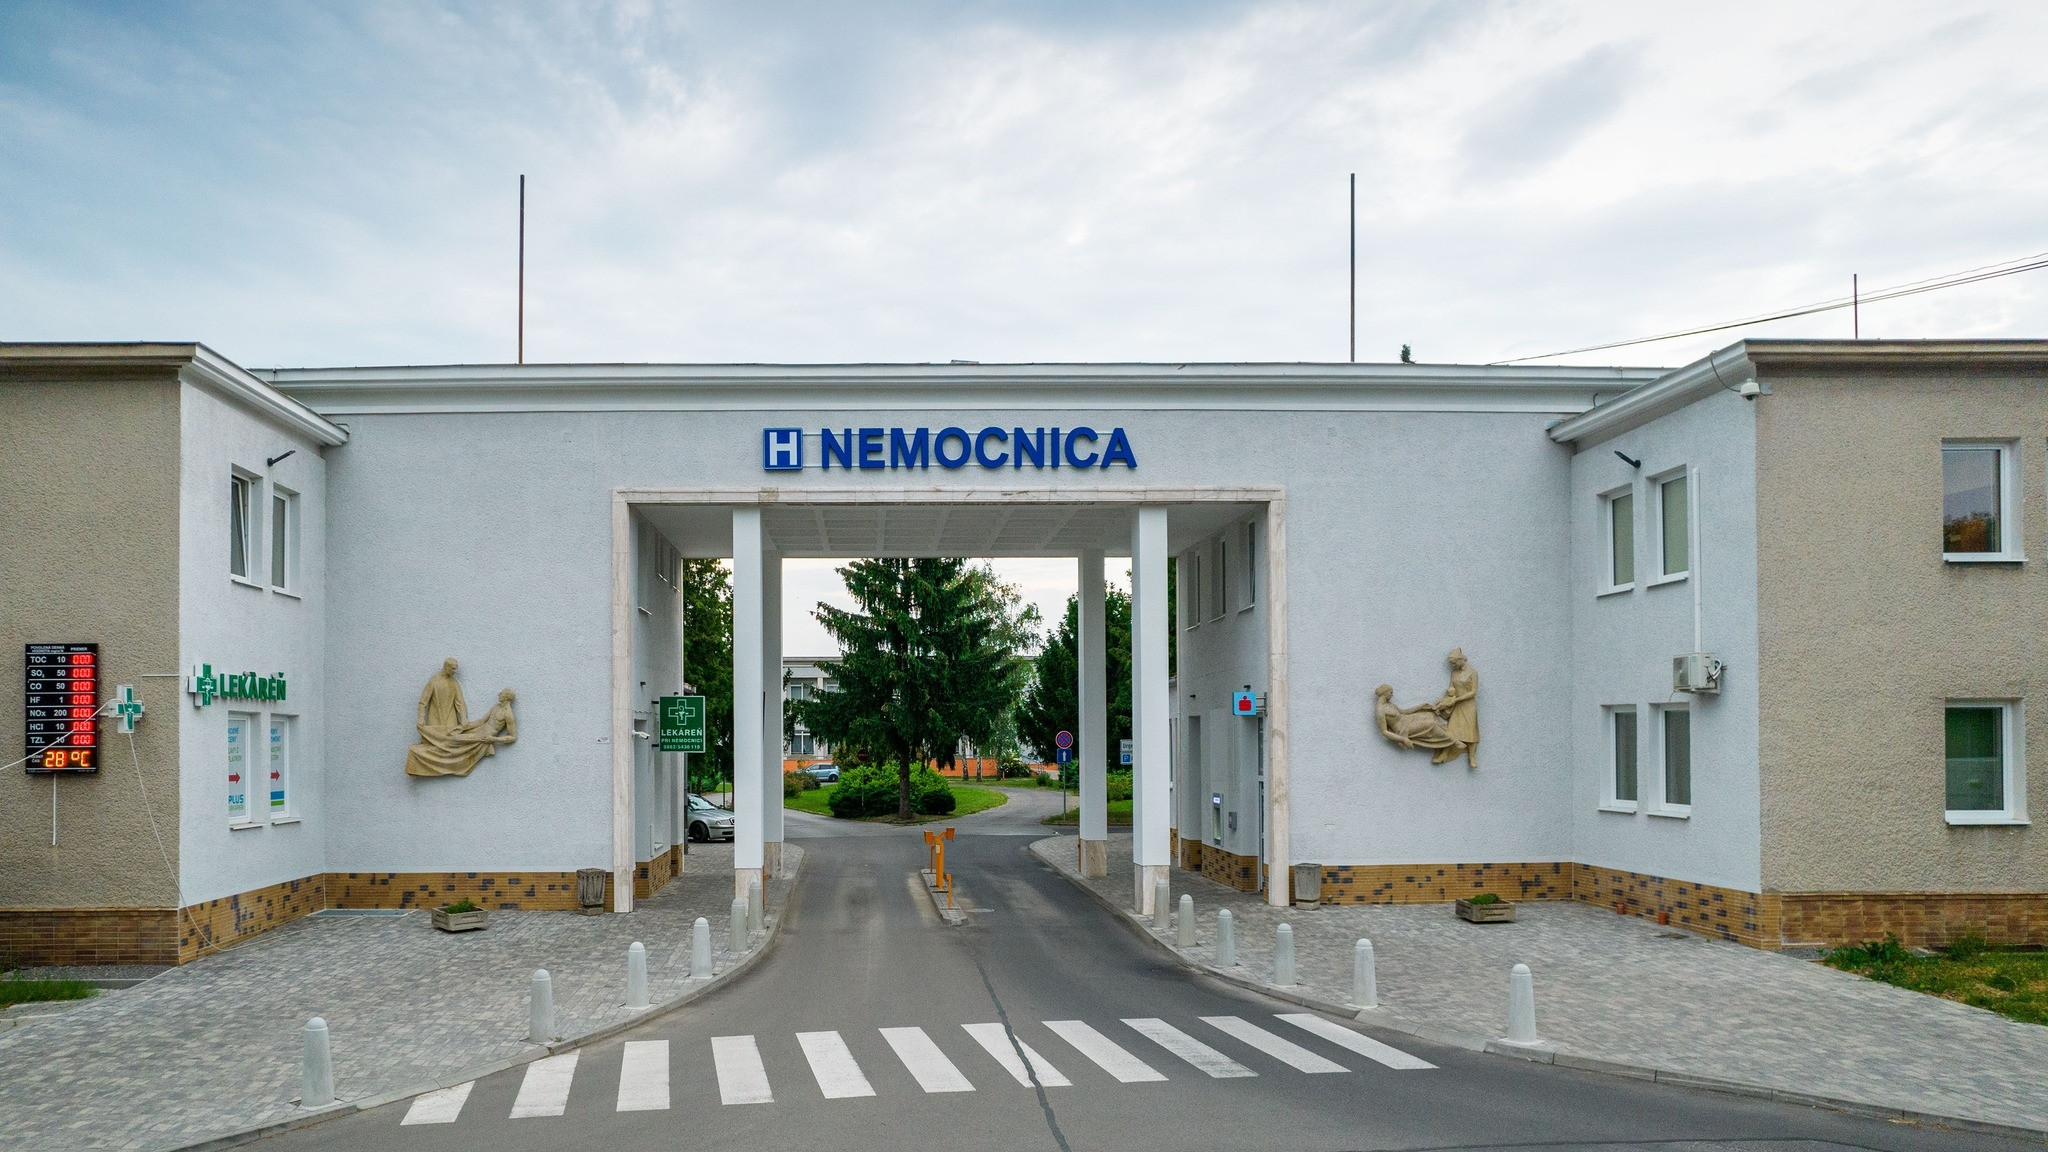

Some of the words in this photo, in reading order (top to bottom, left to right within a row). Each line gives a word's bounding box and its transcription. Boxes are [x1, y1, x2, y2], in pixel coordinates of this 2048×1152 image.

[770, 432, 798, 466] H
[821, 427, 1138, 469] NEMOCNICA
[220, 671, 286, 700] LEKÁREŇ
[661, 727, 702, 736] LEKÁREŇ
[46, 751, 65, 767] 28
